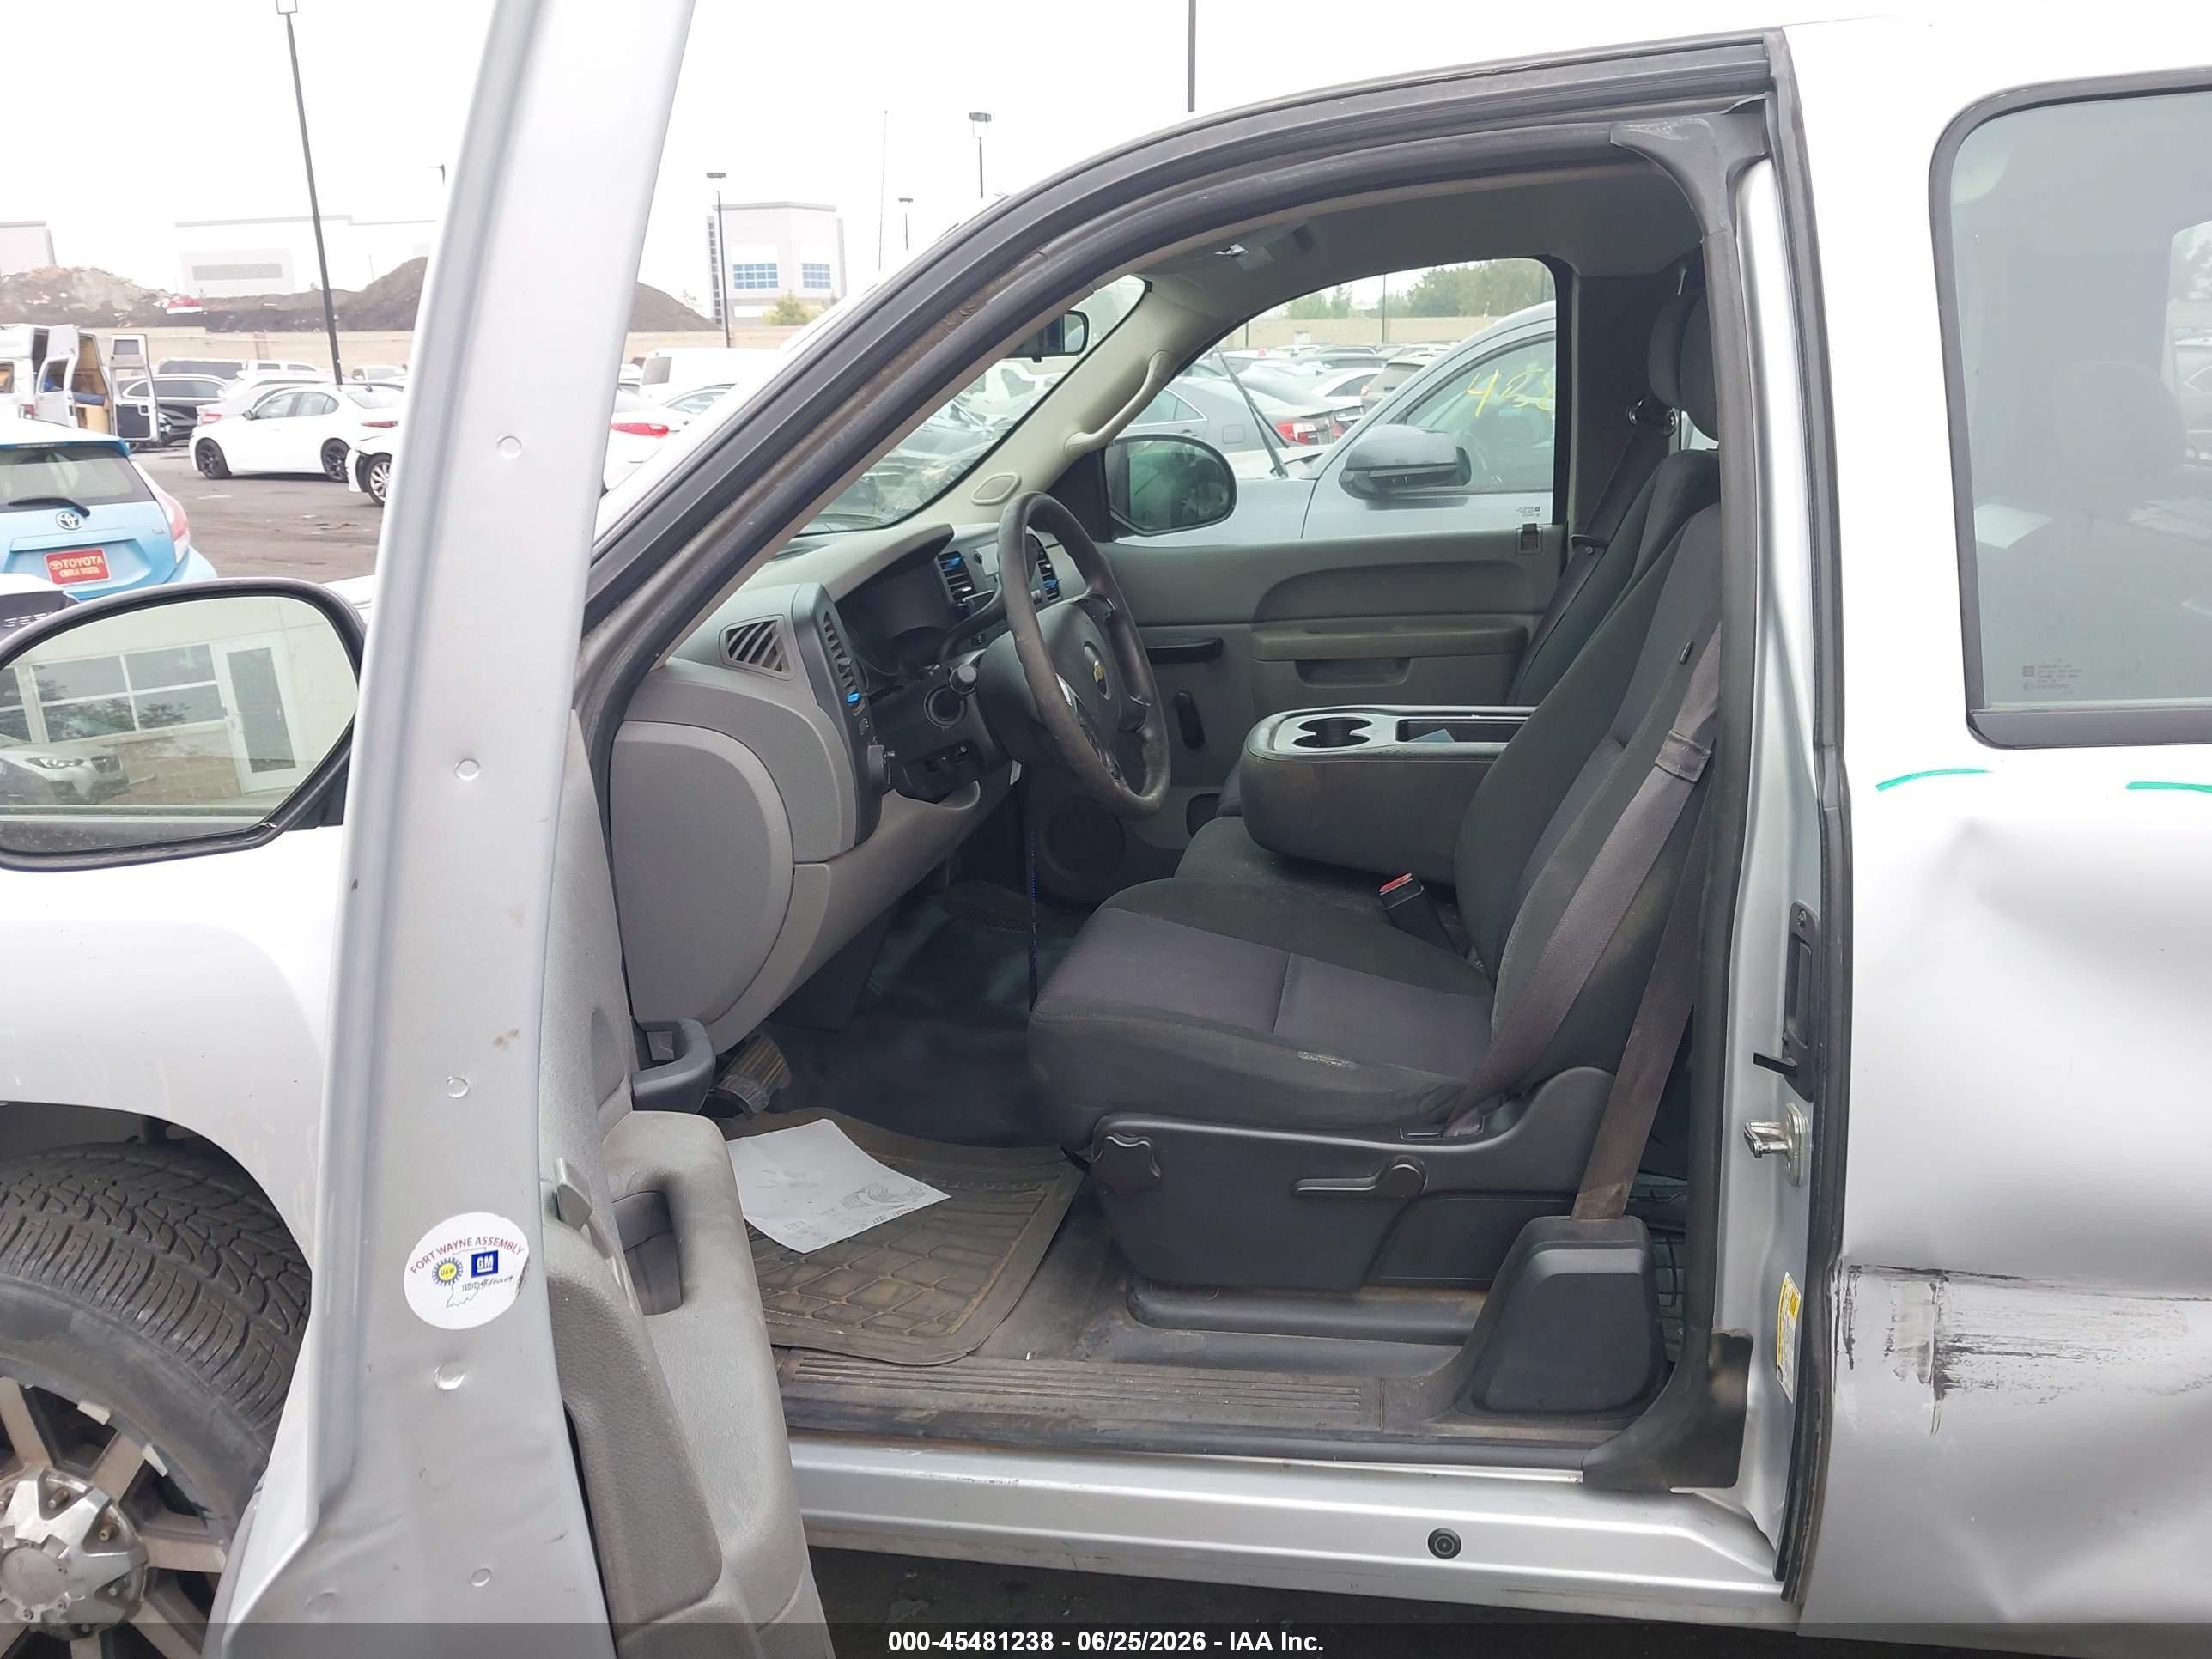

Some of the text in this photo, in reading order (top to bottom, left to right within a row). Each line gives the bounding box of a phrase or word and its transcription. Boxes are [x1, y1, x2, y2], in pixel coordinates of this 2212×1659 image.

[61, 556, 104, 568] TOYOTA
[410, 1236, 525, 1275] FORT WAYNE ASSEMBLY
[440, 1267, 455, 1277] UAW
